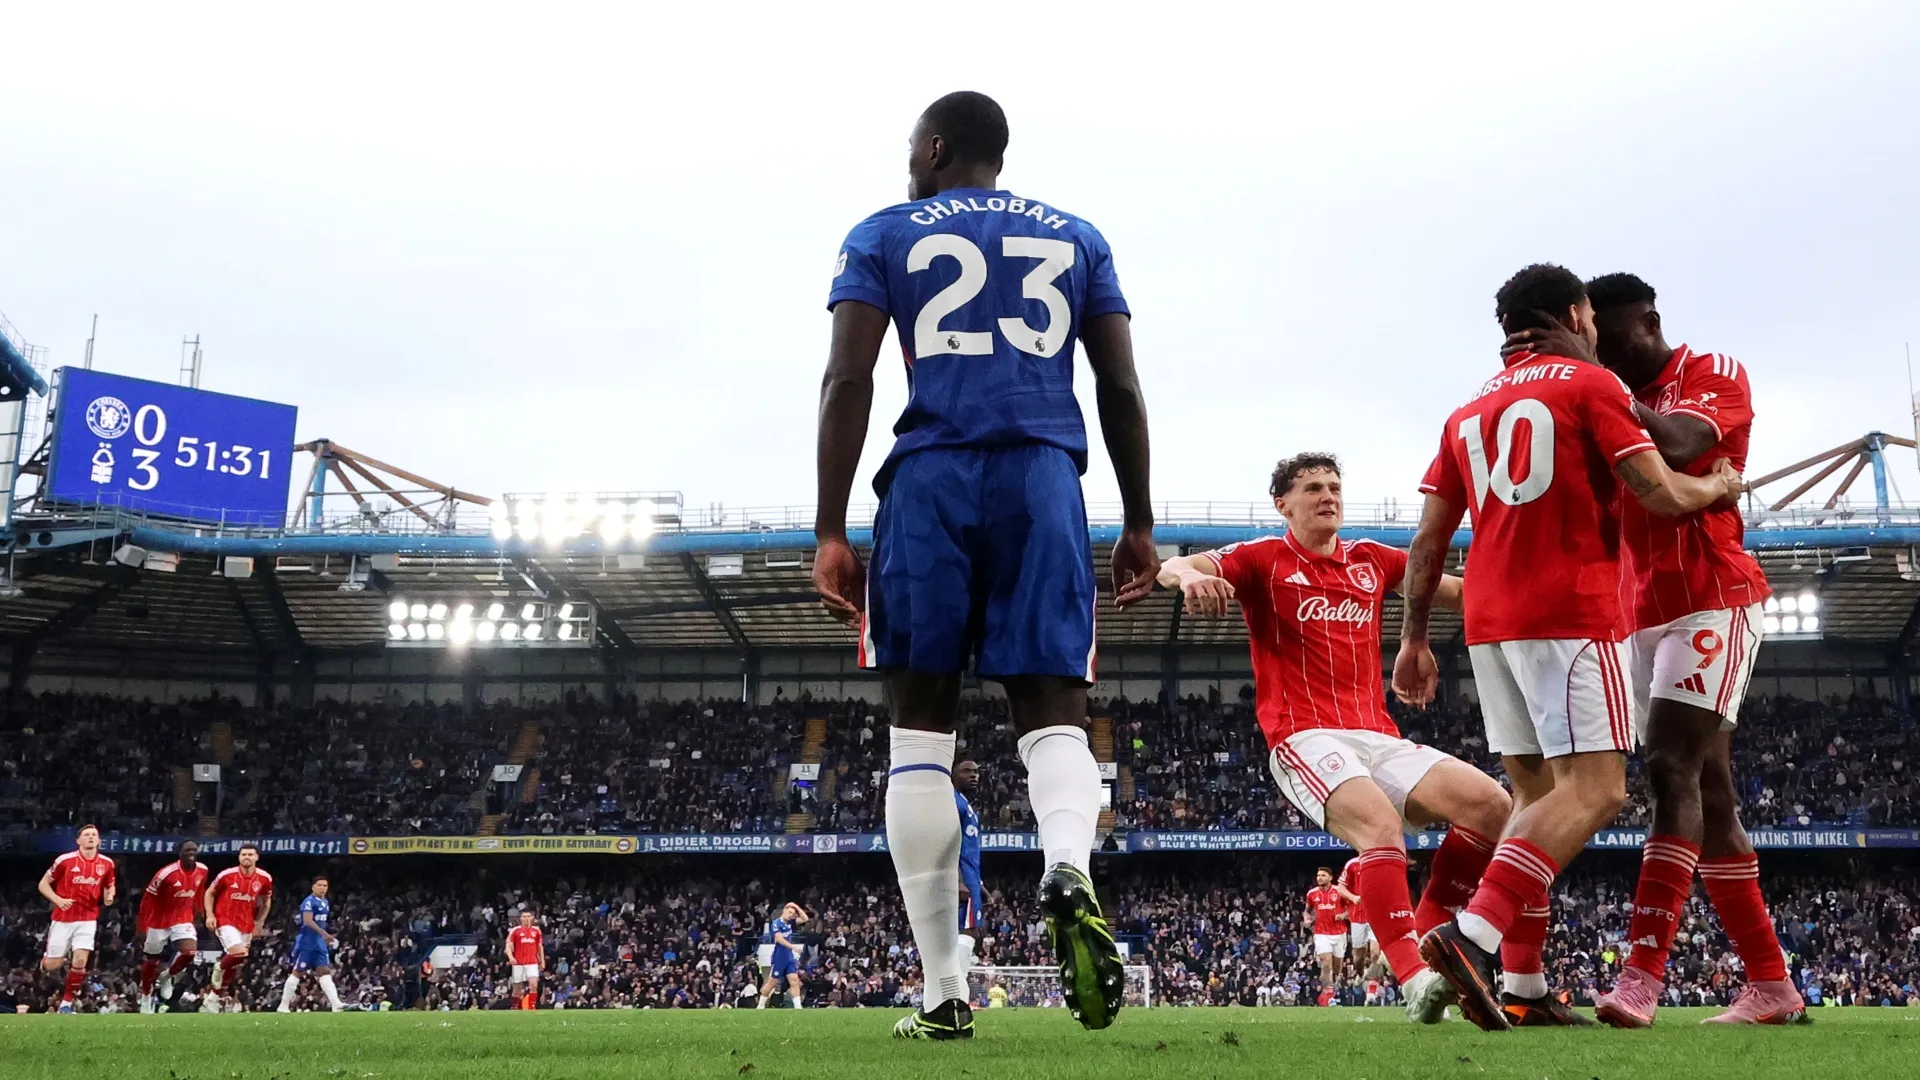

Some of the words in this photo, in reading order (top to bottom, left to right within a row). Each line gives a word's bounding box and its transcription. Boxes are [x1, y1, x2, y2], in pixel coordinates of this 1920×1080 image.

[910, 197, 1069, 231] CHALOBAH
[906, 233, 1075, 359] 23
[134, 404, 167, 446] 0
[174, 436, 271, 479] 51:31
[1458, 398, 1555, 513] 10
[128, 448, 161, 491] 3
[1692, 629, 1723, 669] 9
[504, 766, 515, 774] 10
[801, 765, 811, 773] 11
[373, 840, 389, 849] THE
[416, 839, 444, 849] PLACE
[448, 840, 459, 849] TO
[503, 839, 530, 848] EVERY
[533, 839, 562, 848] OTHER
[566, 839, 612, 849] SATURDAY
[660, 836, 708, 847] DIDIER
[713, 836, 771, 846] DROGBA
[980, 834, 1027, 849] EADER,
[1158, 834, 1207, 842] MATTHEW
[1286, 836, 1304, 847] DE
[1306, 836, 1326, 847] OF
[1594, 833, 1646, 846] LAMP
[1748, 832, 1789, 846] TAKING
[1792, 832, 1812, 845] THE
[1815, 832, 1849, 846] MIKEL
[262, 840, 274, 851] IT
[276, 839, 295, 851] ALL
[1160, 841, 1186, 849] BLUE
[1190, 841, 1196, 849] &
[1234, 841, 1263, 849] ARMY
[1636, 905, 1676, 922] NFFC
[453, 946, 466, 955] 10
